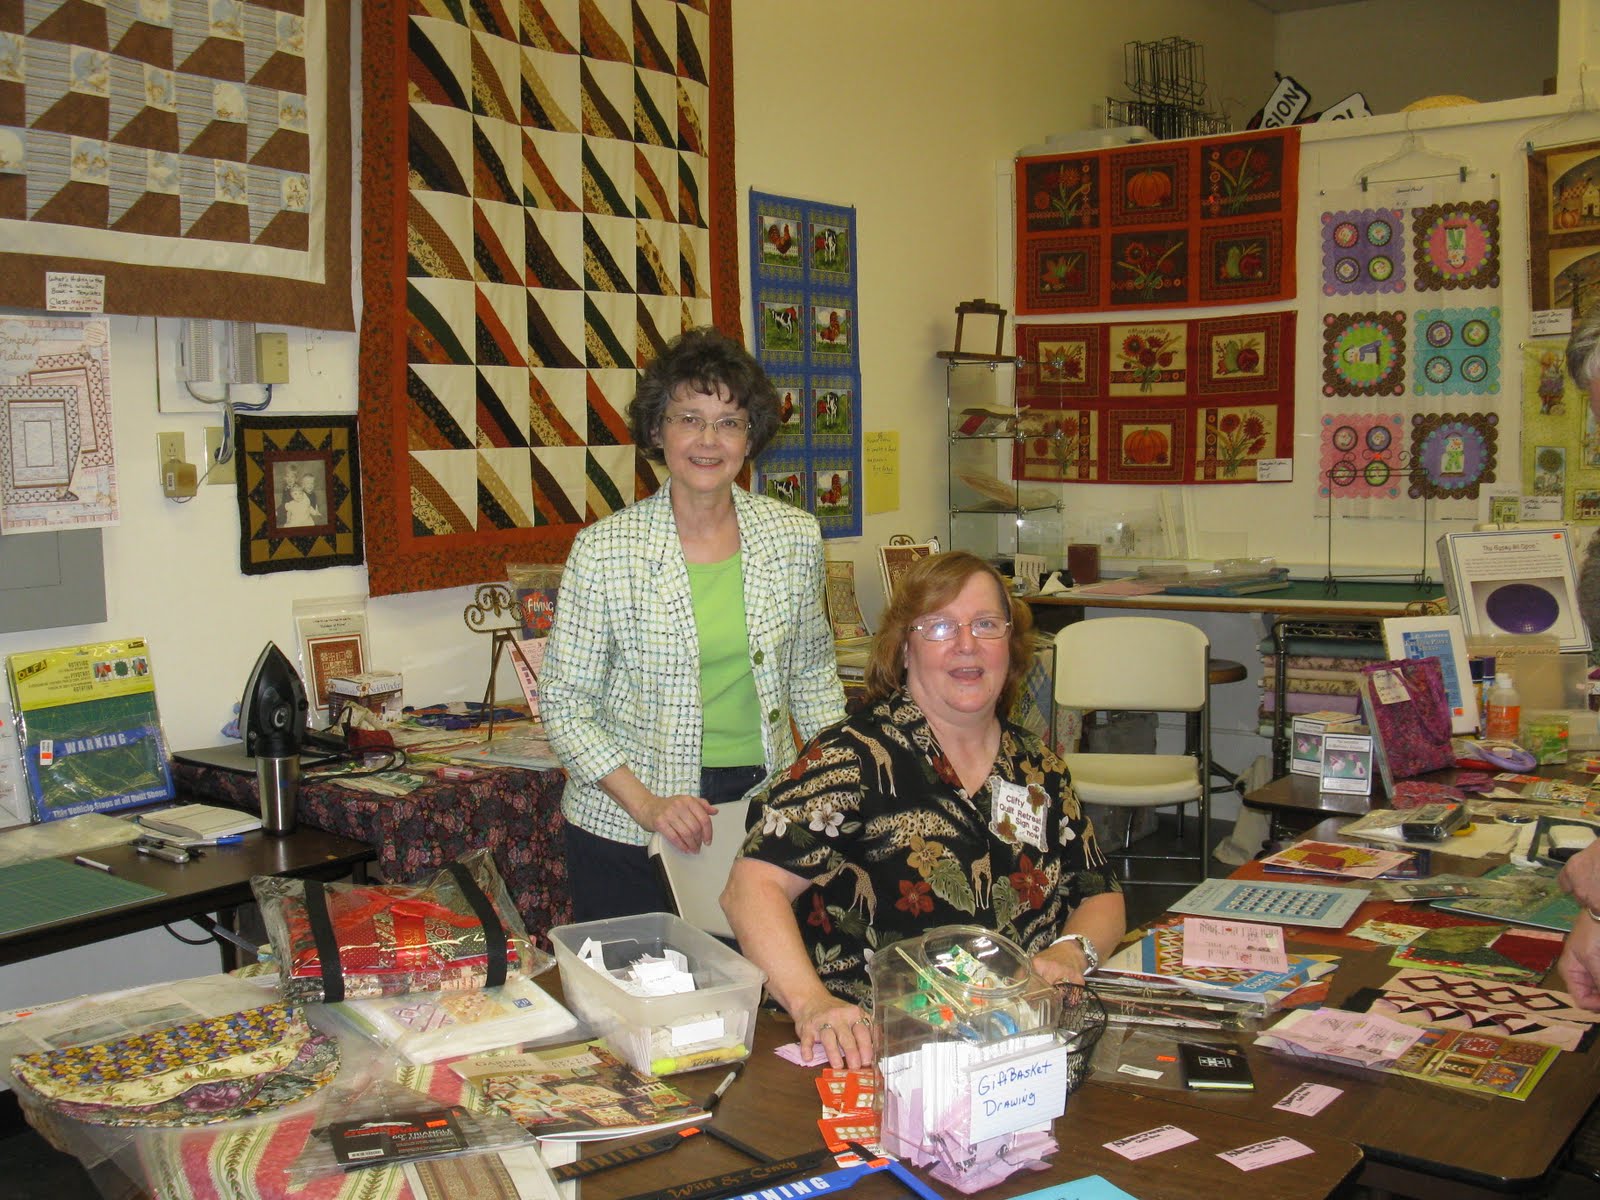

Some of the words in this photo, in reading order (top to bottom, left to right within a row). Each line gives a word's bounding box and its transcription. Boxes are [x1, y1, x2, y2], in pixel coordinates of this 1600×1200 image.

[527, 598, 554, 613] FLYING
[17, 659, 48, 681] OLFA
[64, 733, 127, 755] WARNING
[68, 804, 94, 816] Vehicle
[94, 799, 114, 810] Stops
[1000, 803, 1015, 814] Quilt
[1015, 817, 1030, 829] Sign
[1032, 824, 1040, 833] up
[1026, 830, 1040, 840] now
[667, 1181, 716, 1200] Wild
